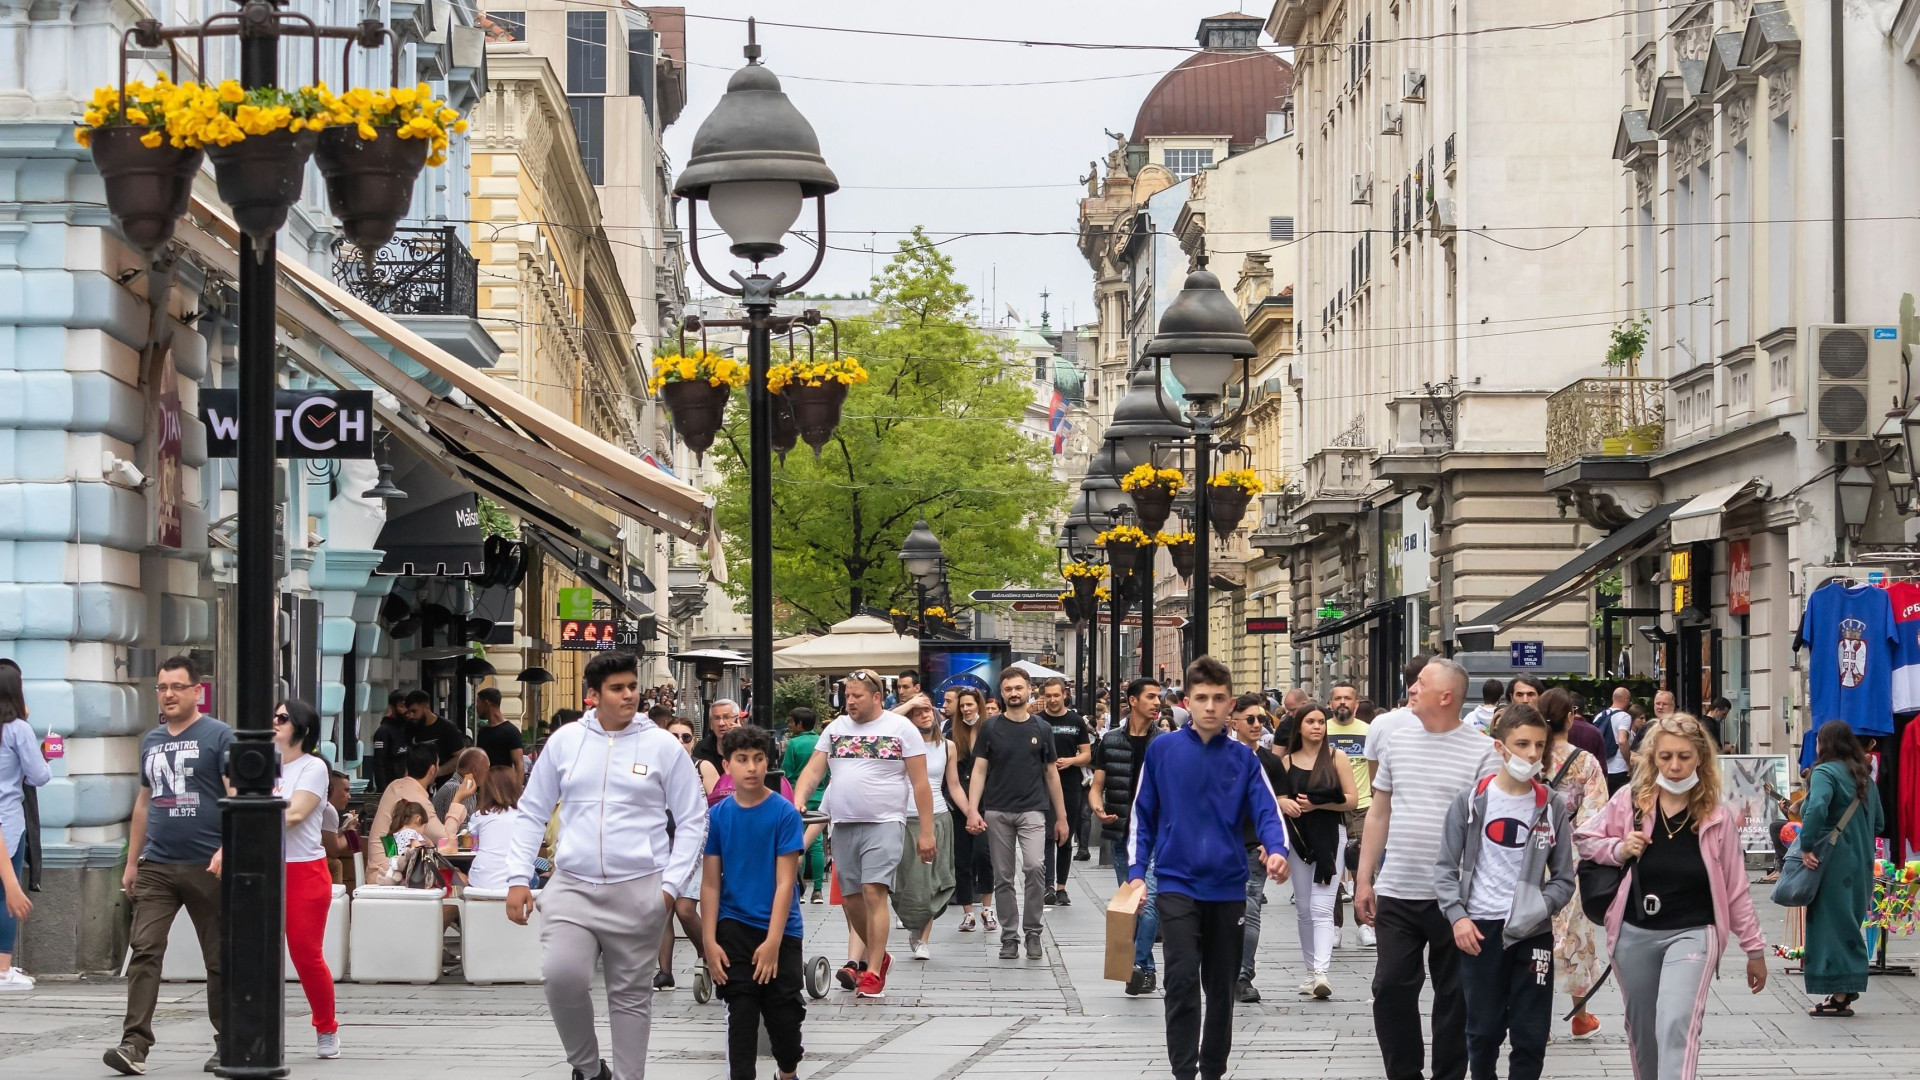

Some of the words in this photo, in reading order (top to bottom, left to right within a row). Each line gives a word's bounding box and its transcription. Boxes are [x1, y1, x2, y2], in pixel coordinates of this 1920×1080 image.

[207, 396, 364, 451] WTCH
[1902, 602, 1920, 618] СРБ
[164, 740, 199, 752] CONTROL
[169, 808, 197, 818] NO.975
[1532, 948, 1551, 962] JUST
[1536, 960, 1548, 974] DO
